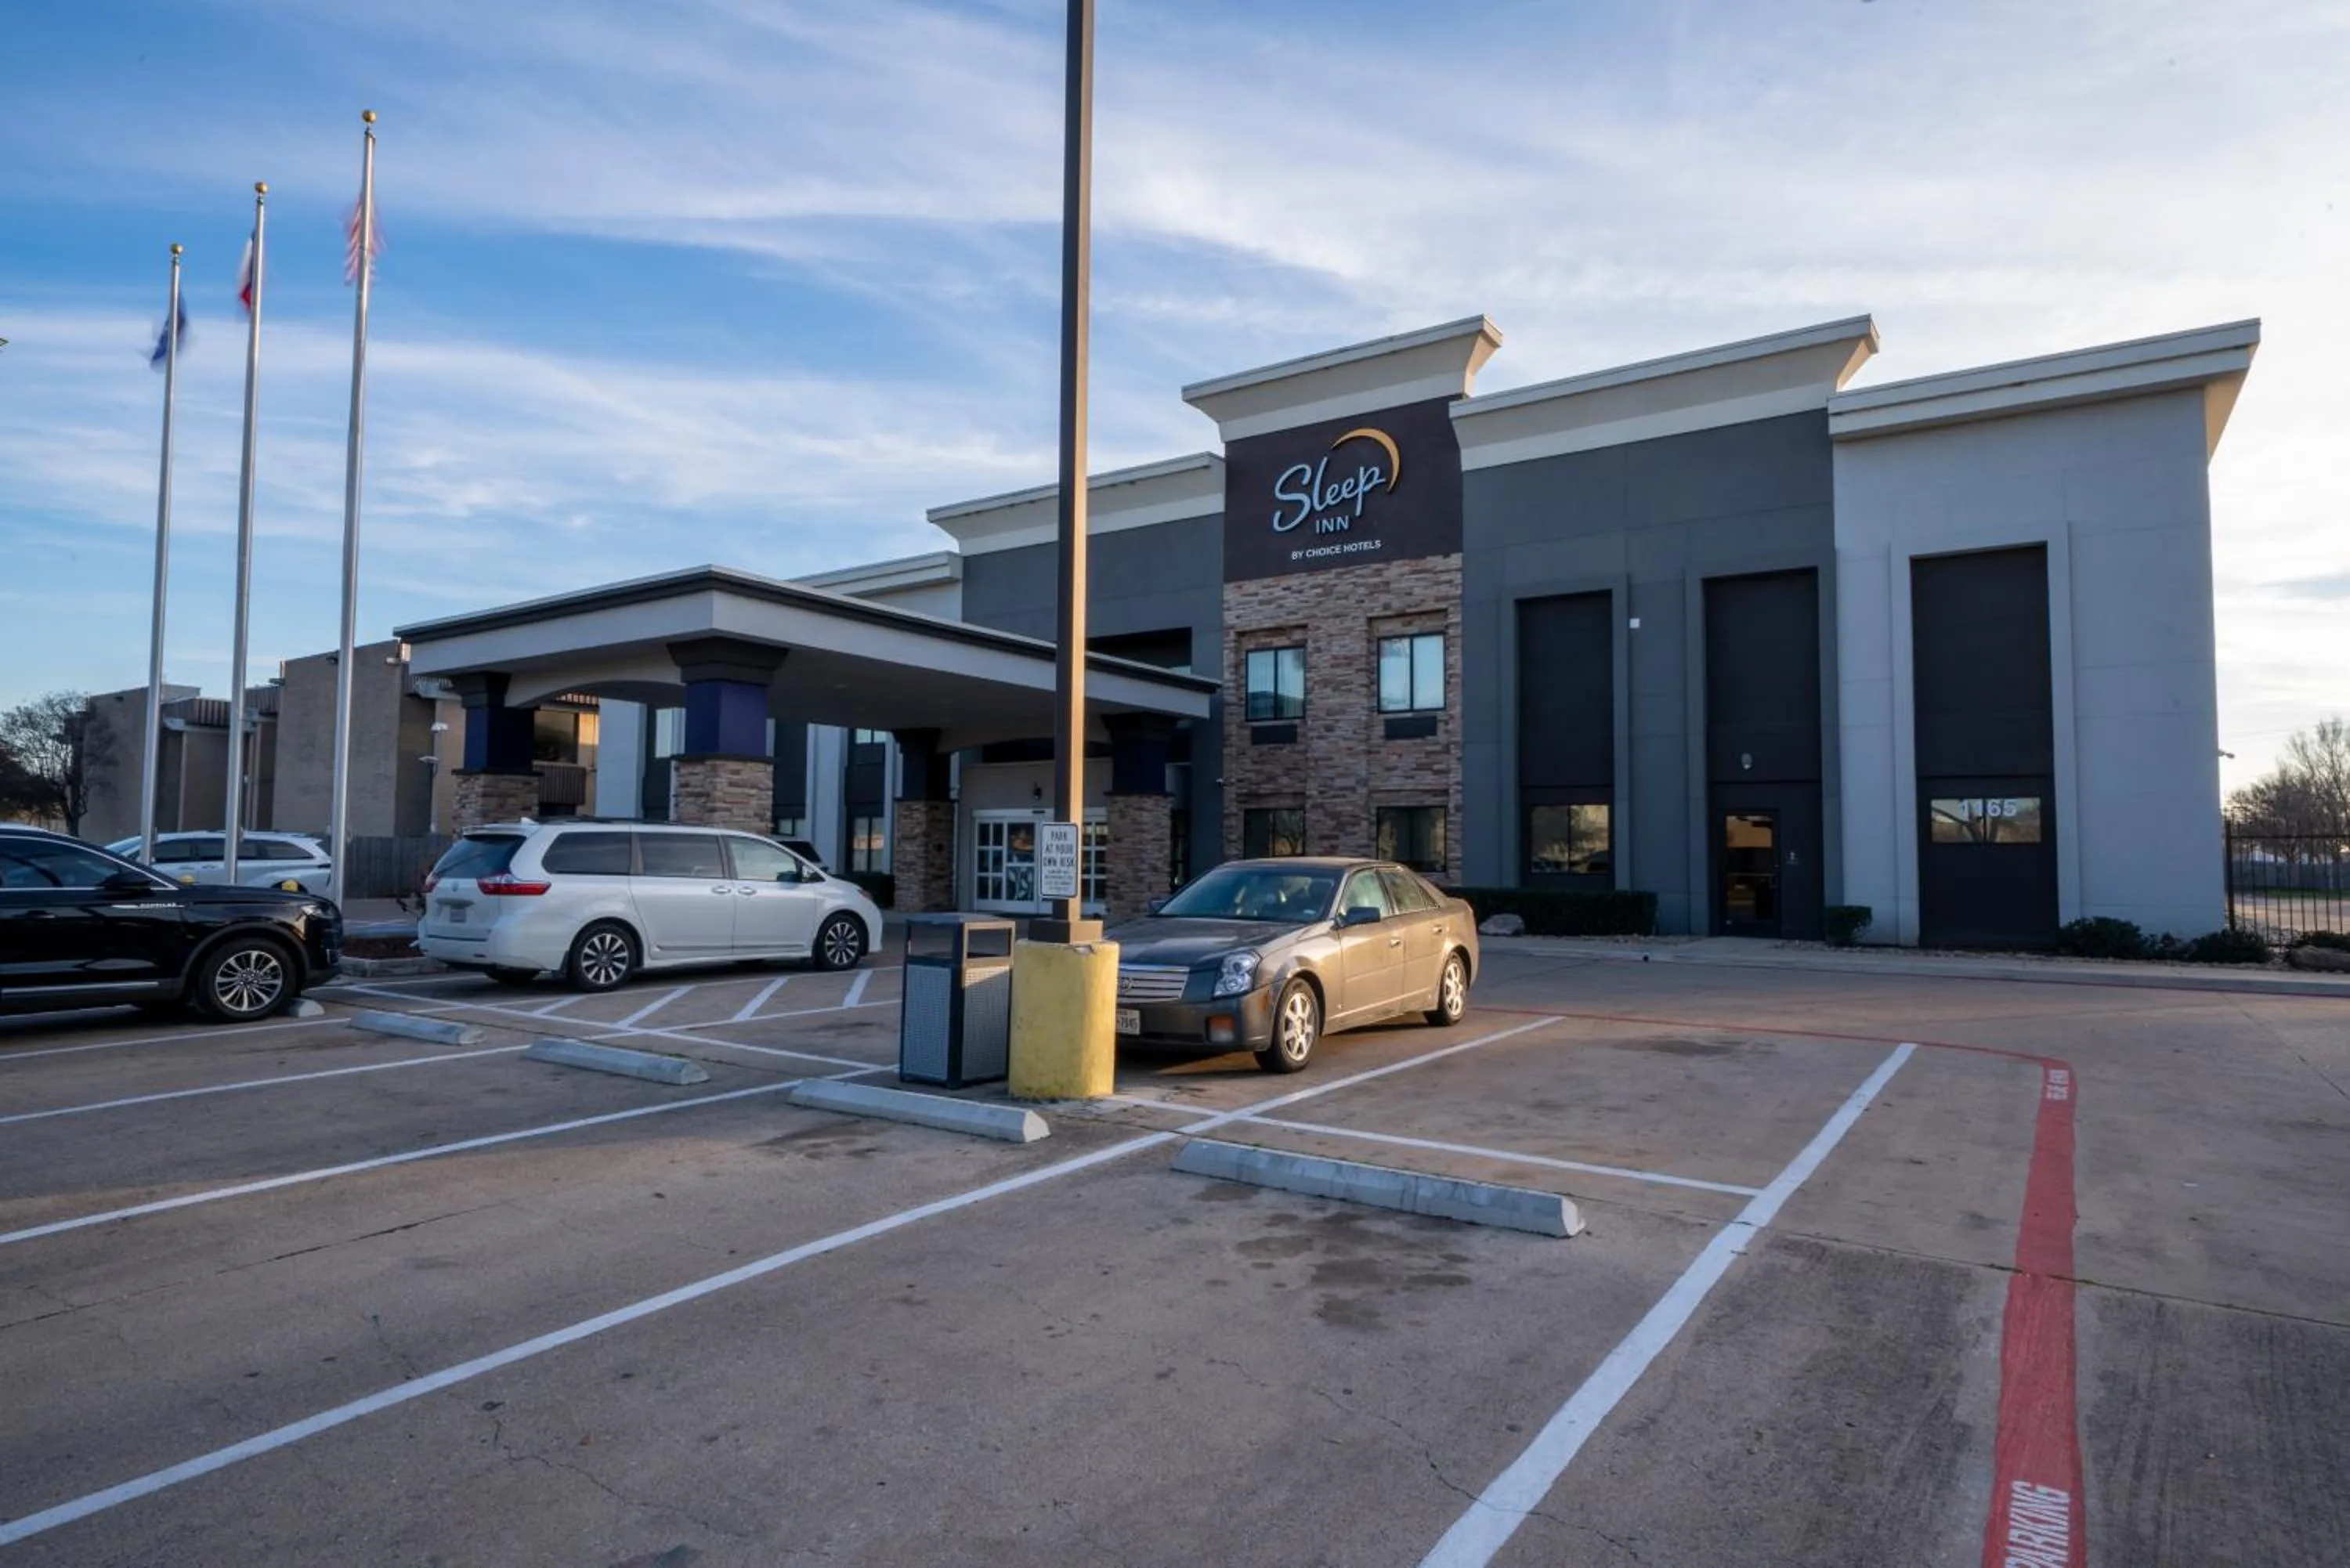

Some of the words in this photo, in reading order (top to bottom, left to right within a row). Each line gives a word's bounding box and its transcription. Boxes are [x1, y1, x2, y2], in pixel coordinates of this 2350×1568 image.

[1272, 456, 1386, 533] Sleep
[1315, 515, 1350, 535] INN
[1291, 551, 1304, 561] BY
[1306, 544, 1342, 558] CHOICE
[1343, 540, 1382, 553] HOTELS
[1959, 799, 2017, 819] 1165
[1050, 831, 1068, 841] PARK
[1045, 844, 1054, 854] AT
